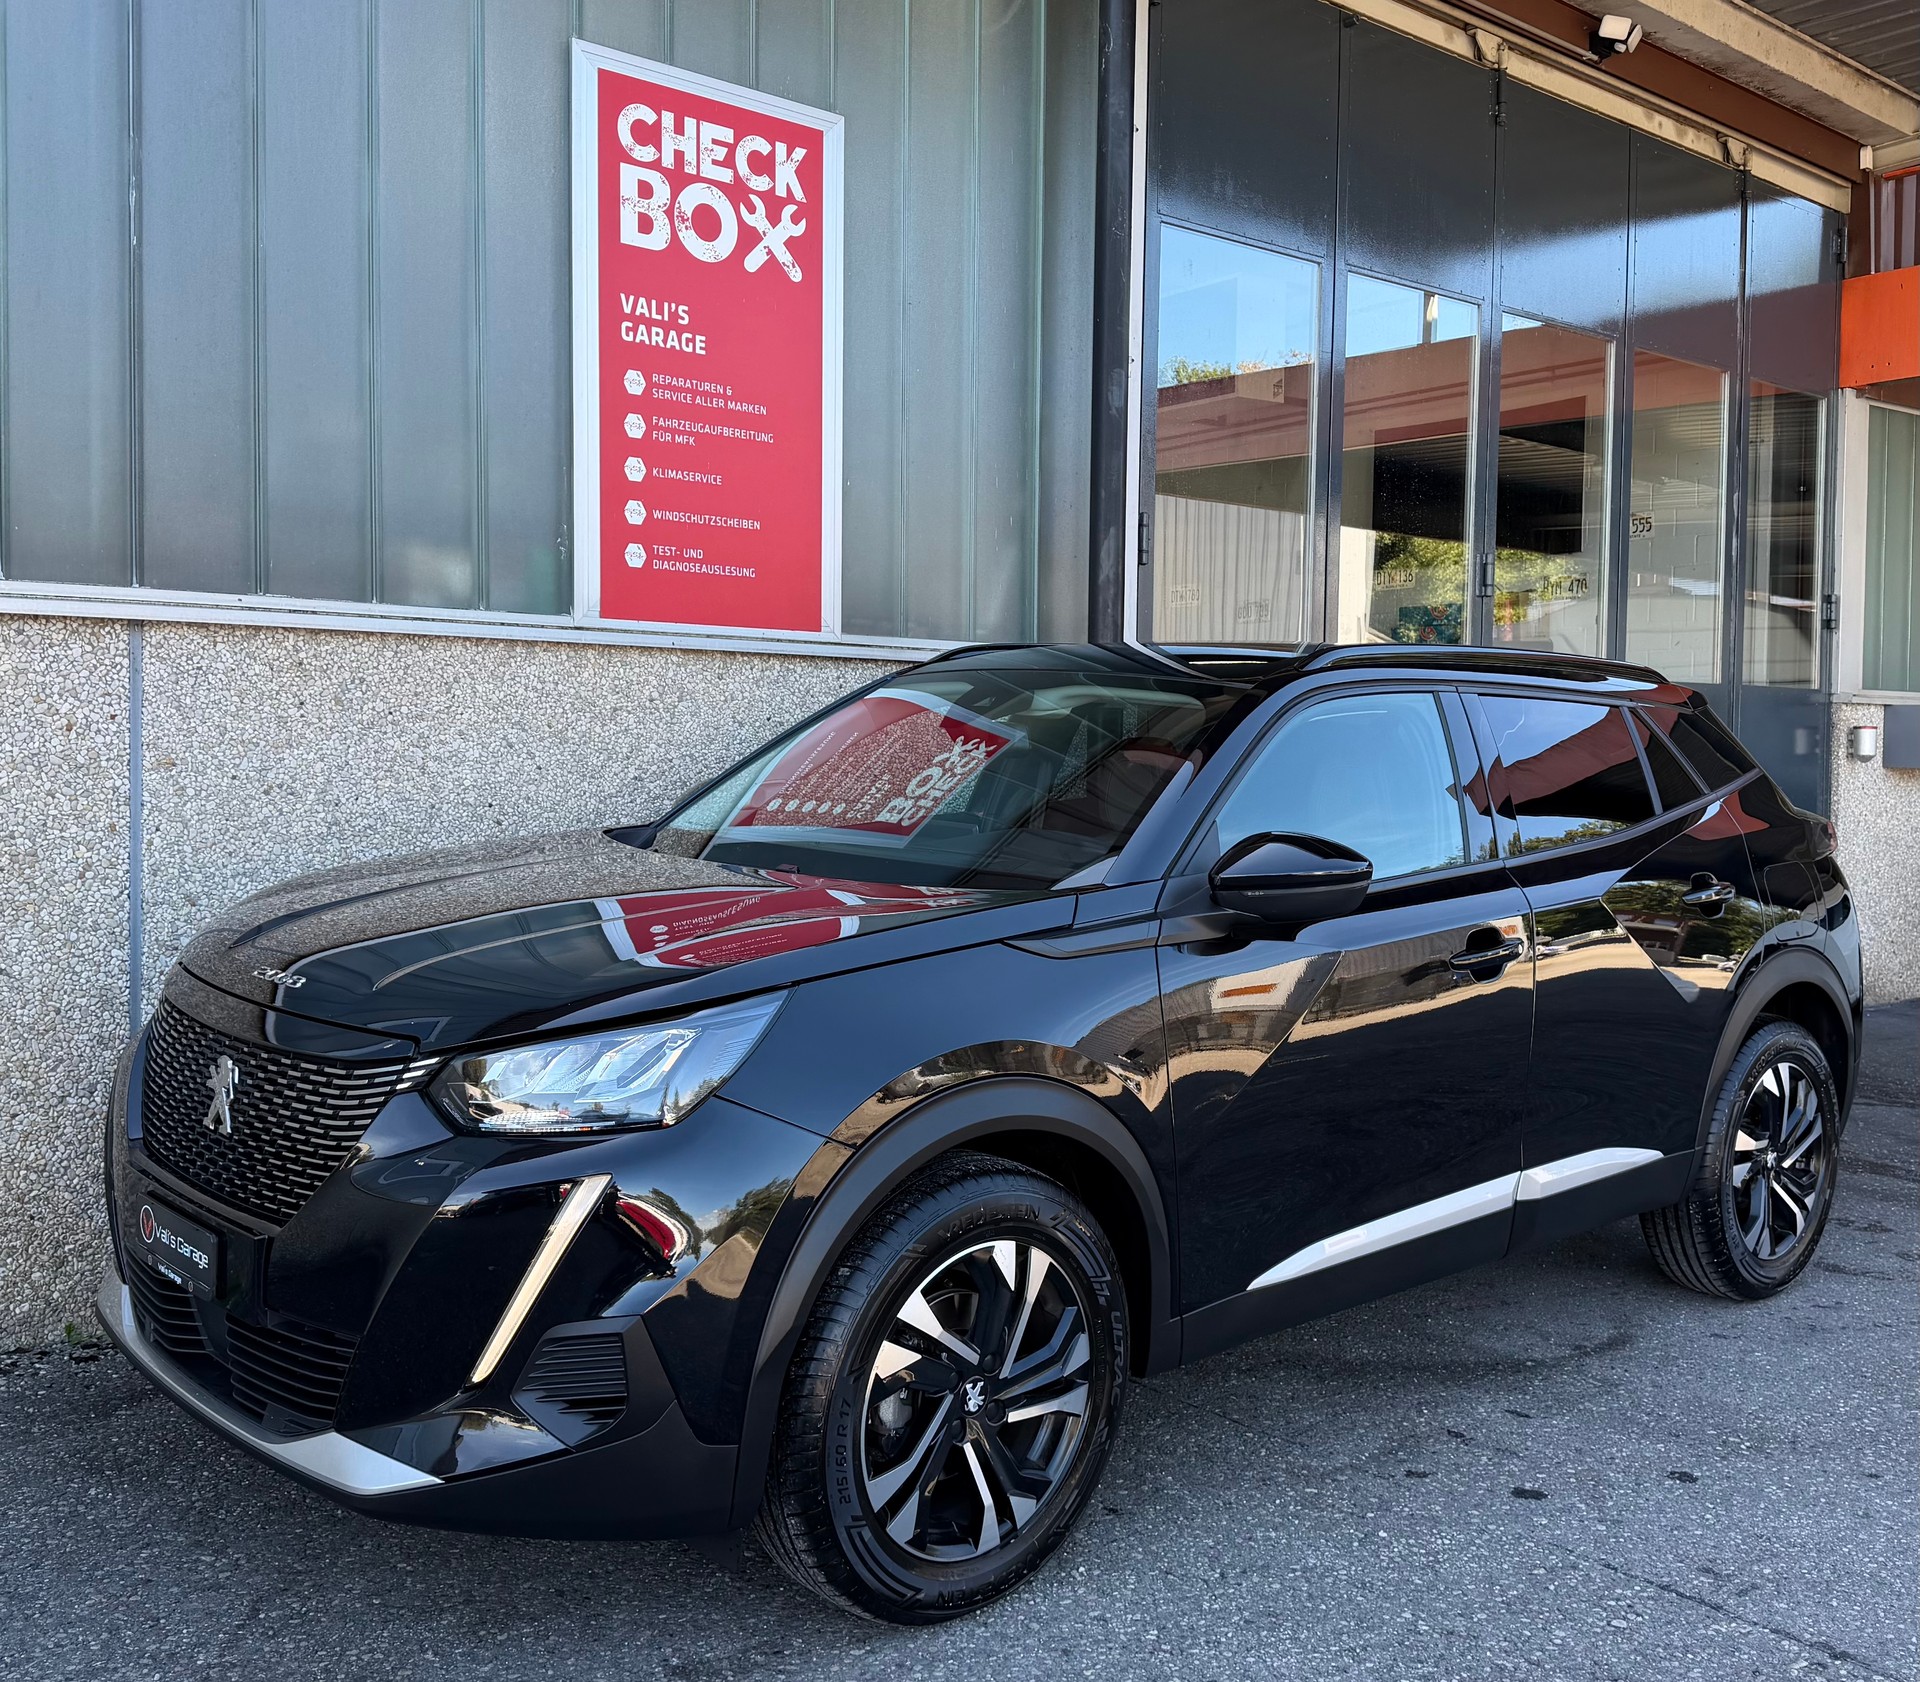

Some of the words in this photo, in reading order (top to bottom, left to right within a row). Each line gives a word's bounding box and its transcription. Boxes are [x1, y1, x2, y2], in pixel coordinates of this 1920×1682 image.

[617, 103, 807, 203] CHECK
[619, 162, 806, 283] BOX
[620, 293, 690, 325] VALI'S
[620, 321, 706, 355] GARAGE
[652, 373, 724, 395] REPARATUREN
[726, 386, 733, 396] &
[652, 388, 692, 404] SERVICE
[695, 395, 725, 409] ALLER
[727, 400, 767, 415] MARKEN
[652, 416, 774, 443] FAHRZEUGAUFBEREITUNG
[652, 430, 672, 443] FÜR
[675, 434, 696, 446] MFK
[652, 467, 723, 485] KLIMASERVICE
[652, 509, 761, 530] WINDSCHUTZSCHEIBEN
[1631, 516, 1652, 534] 555
[652, 544, 681, 556] TEST-
[683, 548, 704, 559] UND
[653, 559, 756, 578] DIAGNOSEAUSLESUNG
[177, 1236, 209, 1269] Garage
